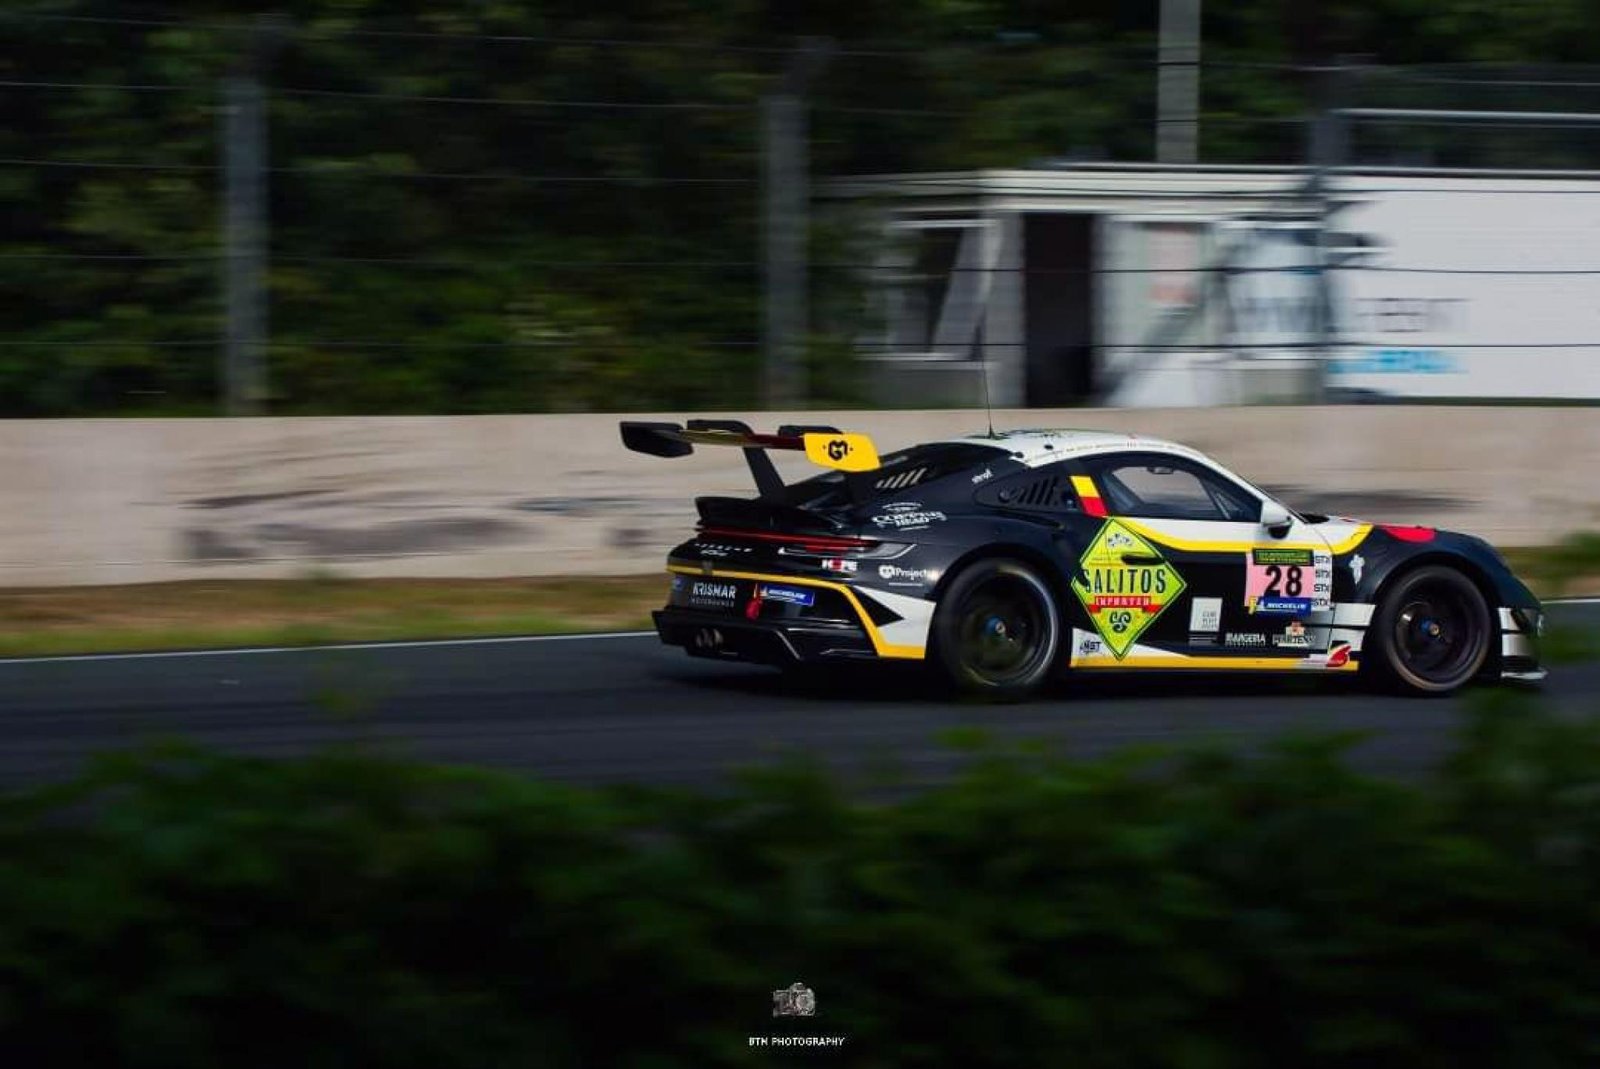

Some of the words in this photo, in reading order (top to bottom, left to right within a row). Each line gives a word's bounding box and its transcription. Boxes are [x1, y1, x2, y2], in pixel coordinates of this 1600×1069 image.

[693, 581, 737, 600] KRISMAR
[1082, 568, 1167, 594] SALITOS
[1264, 565, 1303, 597] 28
